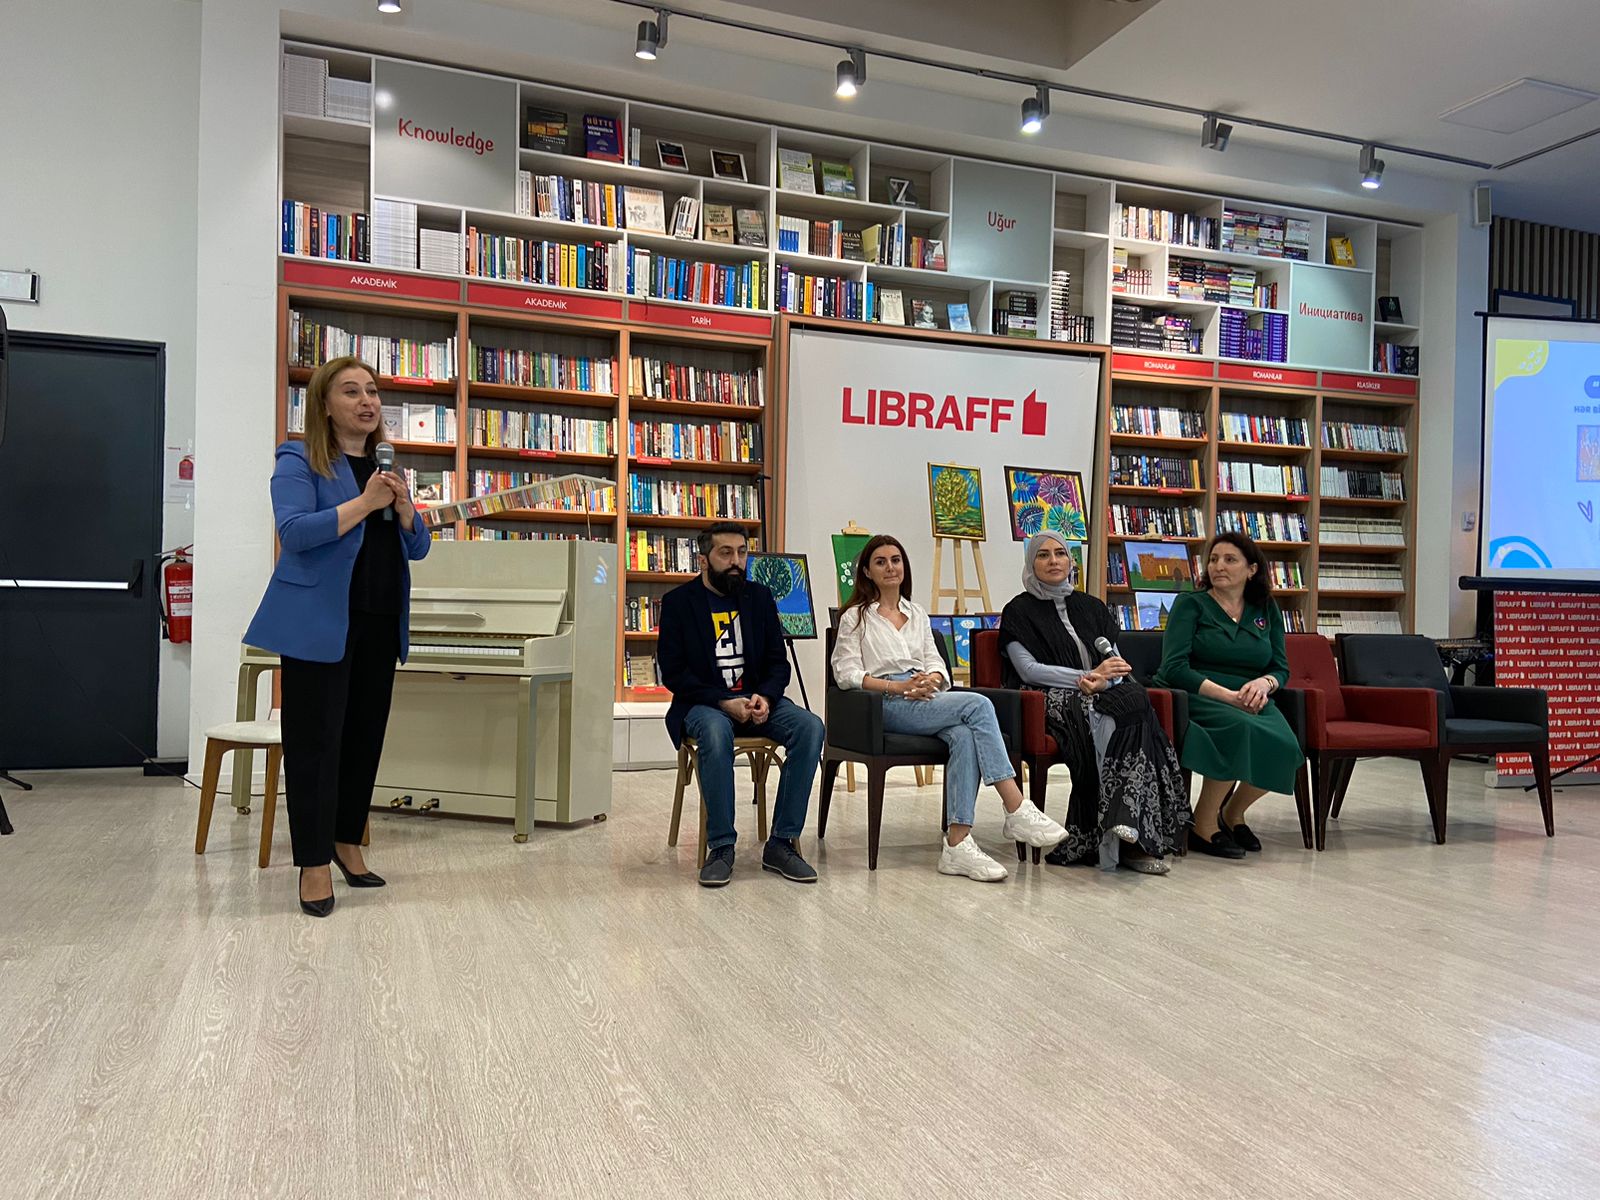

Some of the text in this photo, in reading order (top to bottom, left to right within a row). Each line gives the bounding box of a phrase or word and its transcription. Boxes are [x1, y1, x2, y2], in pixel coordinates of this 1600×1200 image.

[586, 117, 613, 128] HÜTTE
[398, 118, 494, 154] Knowledge
[988, 211, 1016, 232] Uğur
[350, 276, 398, 289] AKADEMİK
[525, 297, 567, 310] AKADEMİK
[1299, 302, 1364, 324] Инициатива
[691, 316, 712, 326] TARİH
[1144, 361, 1176, 370] ROMANLAR
[1253, 370, 1282, 381] ROMANLAR
[842, 387, 1014, 432] LIBRAFF
[1574, 405, 1591, 414] HƏR
